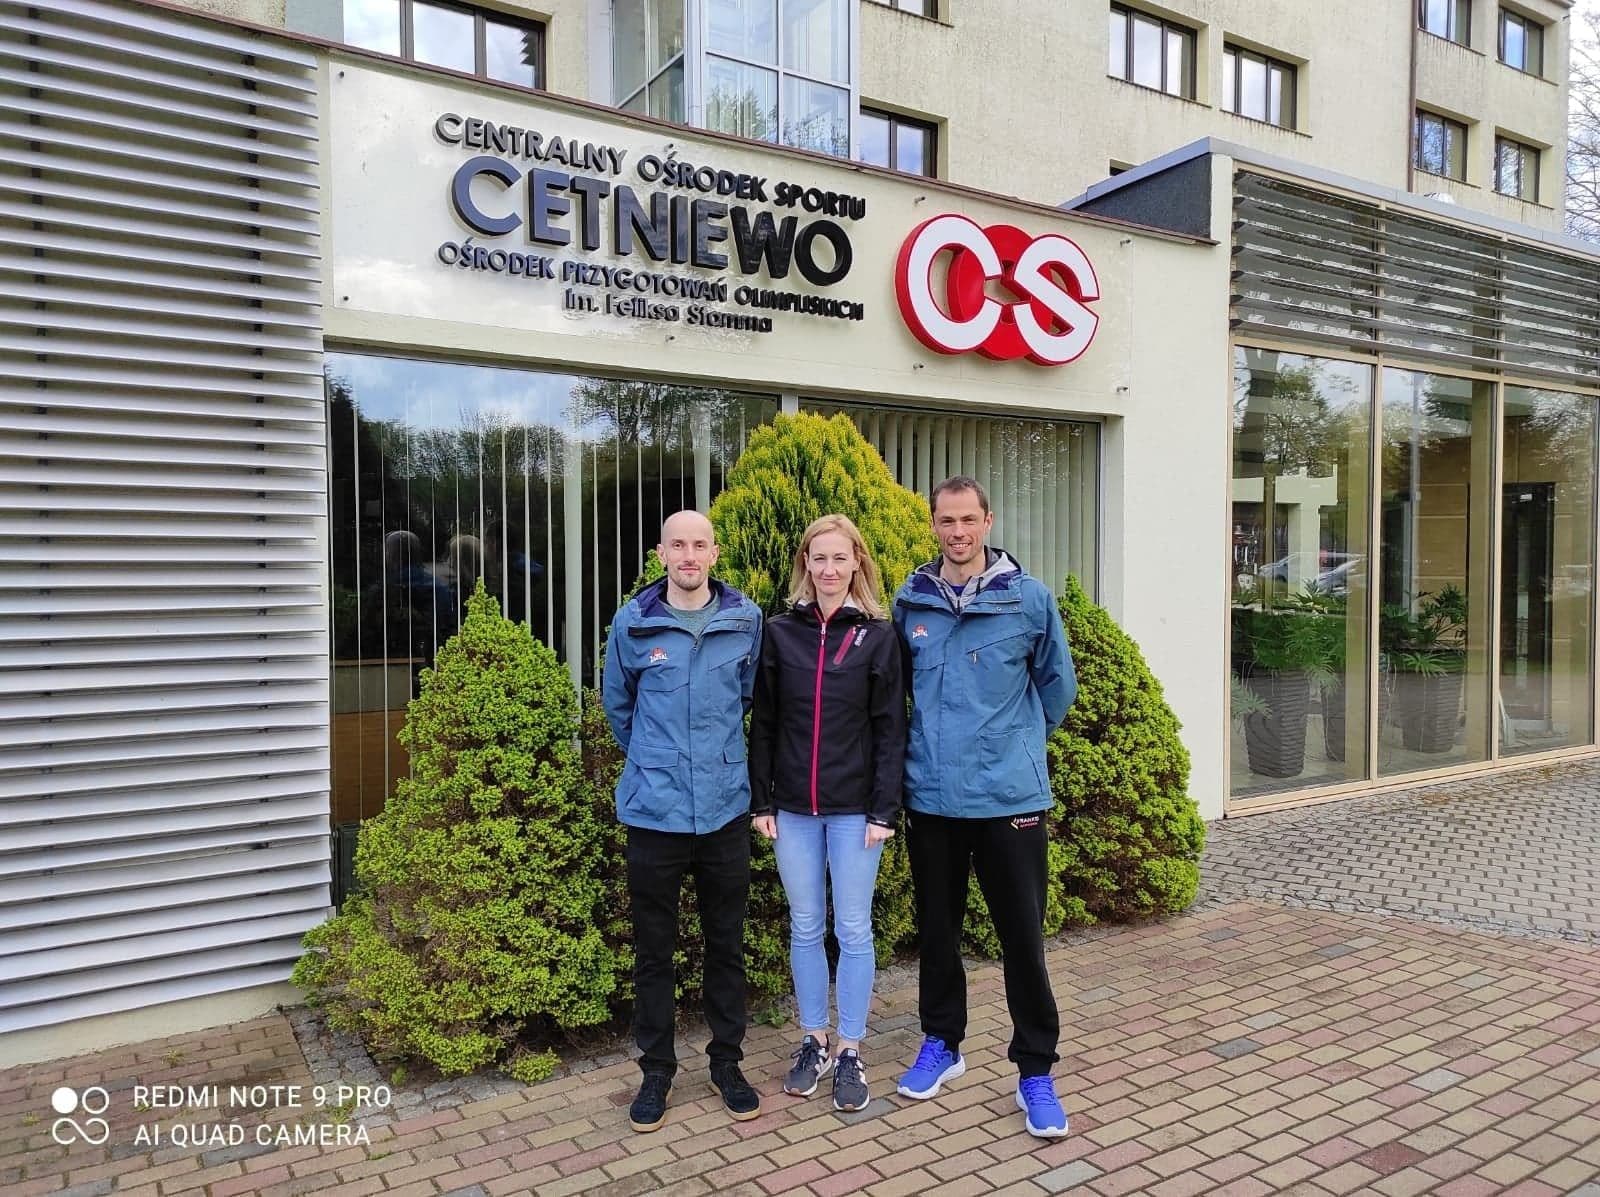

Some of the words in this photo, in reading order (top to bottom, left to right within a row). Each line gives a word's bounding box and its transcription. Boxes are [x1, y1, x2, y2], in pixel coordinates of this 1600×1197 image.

[435, 112, 628, 175] CENTRALNY
[637, 144, 768, 202] OŚRODEK
[773, 181, 866, 221] SPORTU
[451, 155, 853, 287] CETNIEWO
[438, 236, 555, 279] OŚRODEK
[562, 260, 728, 303] PRZYGOTOWAŃ
[605, 292, 681, 322] Feliksa
[687, 303, 773, 333] Stamma
